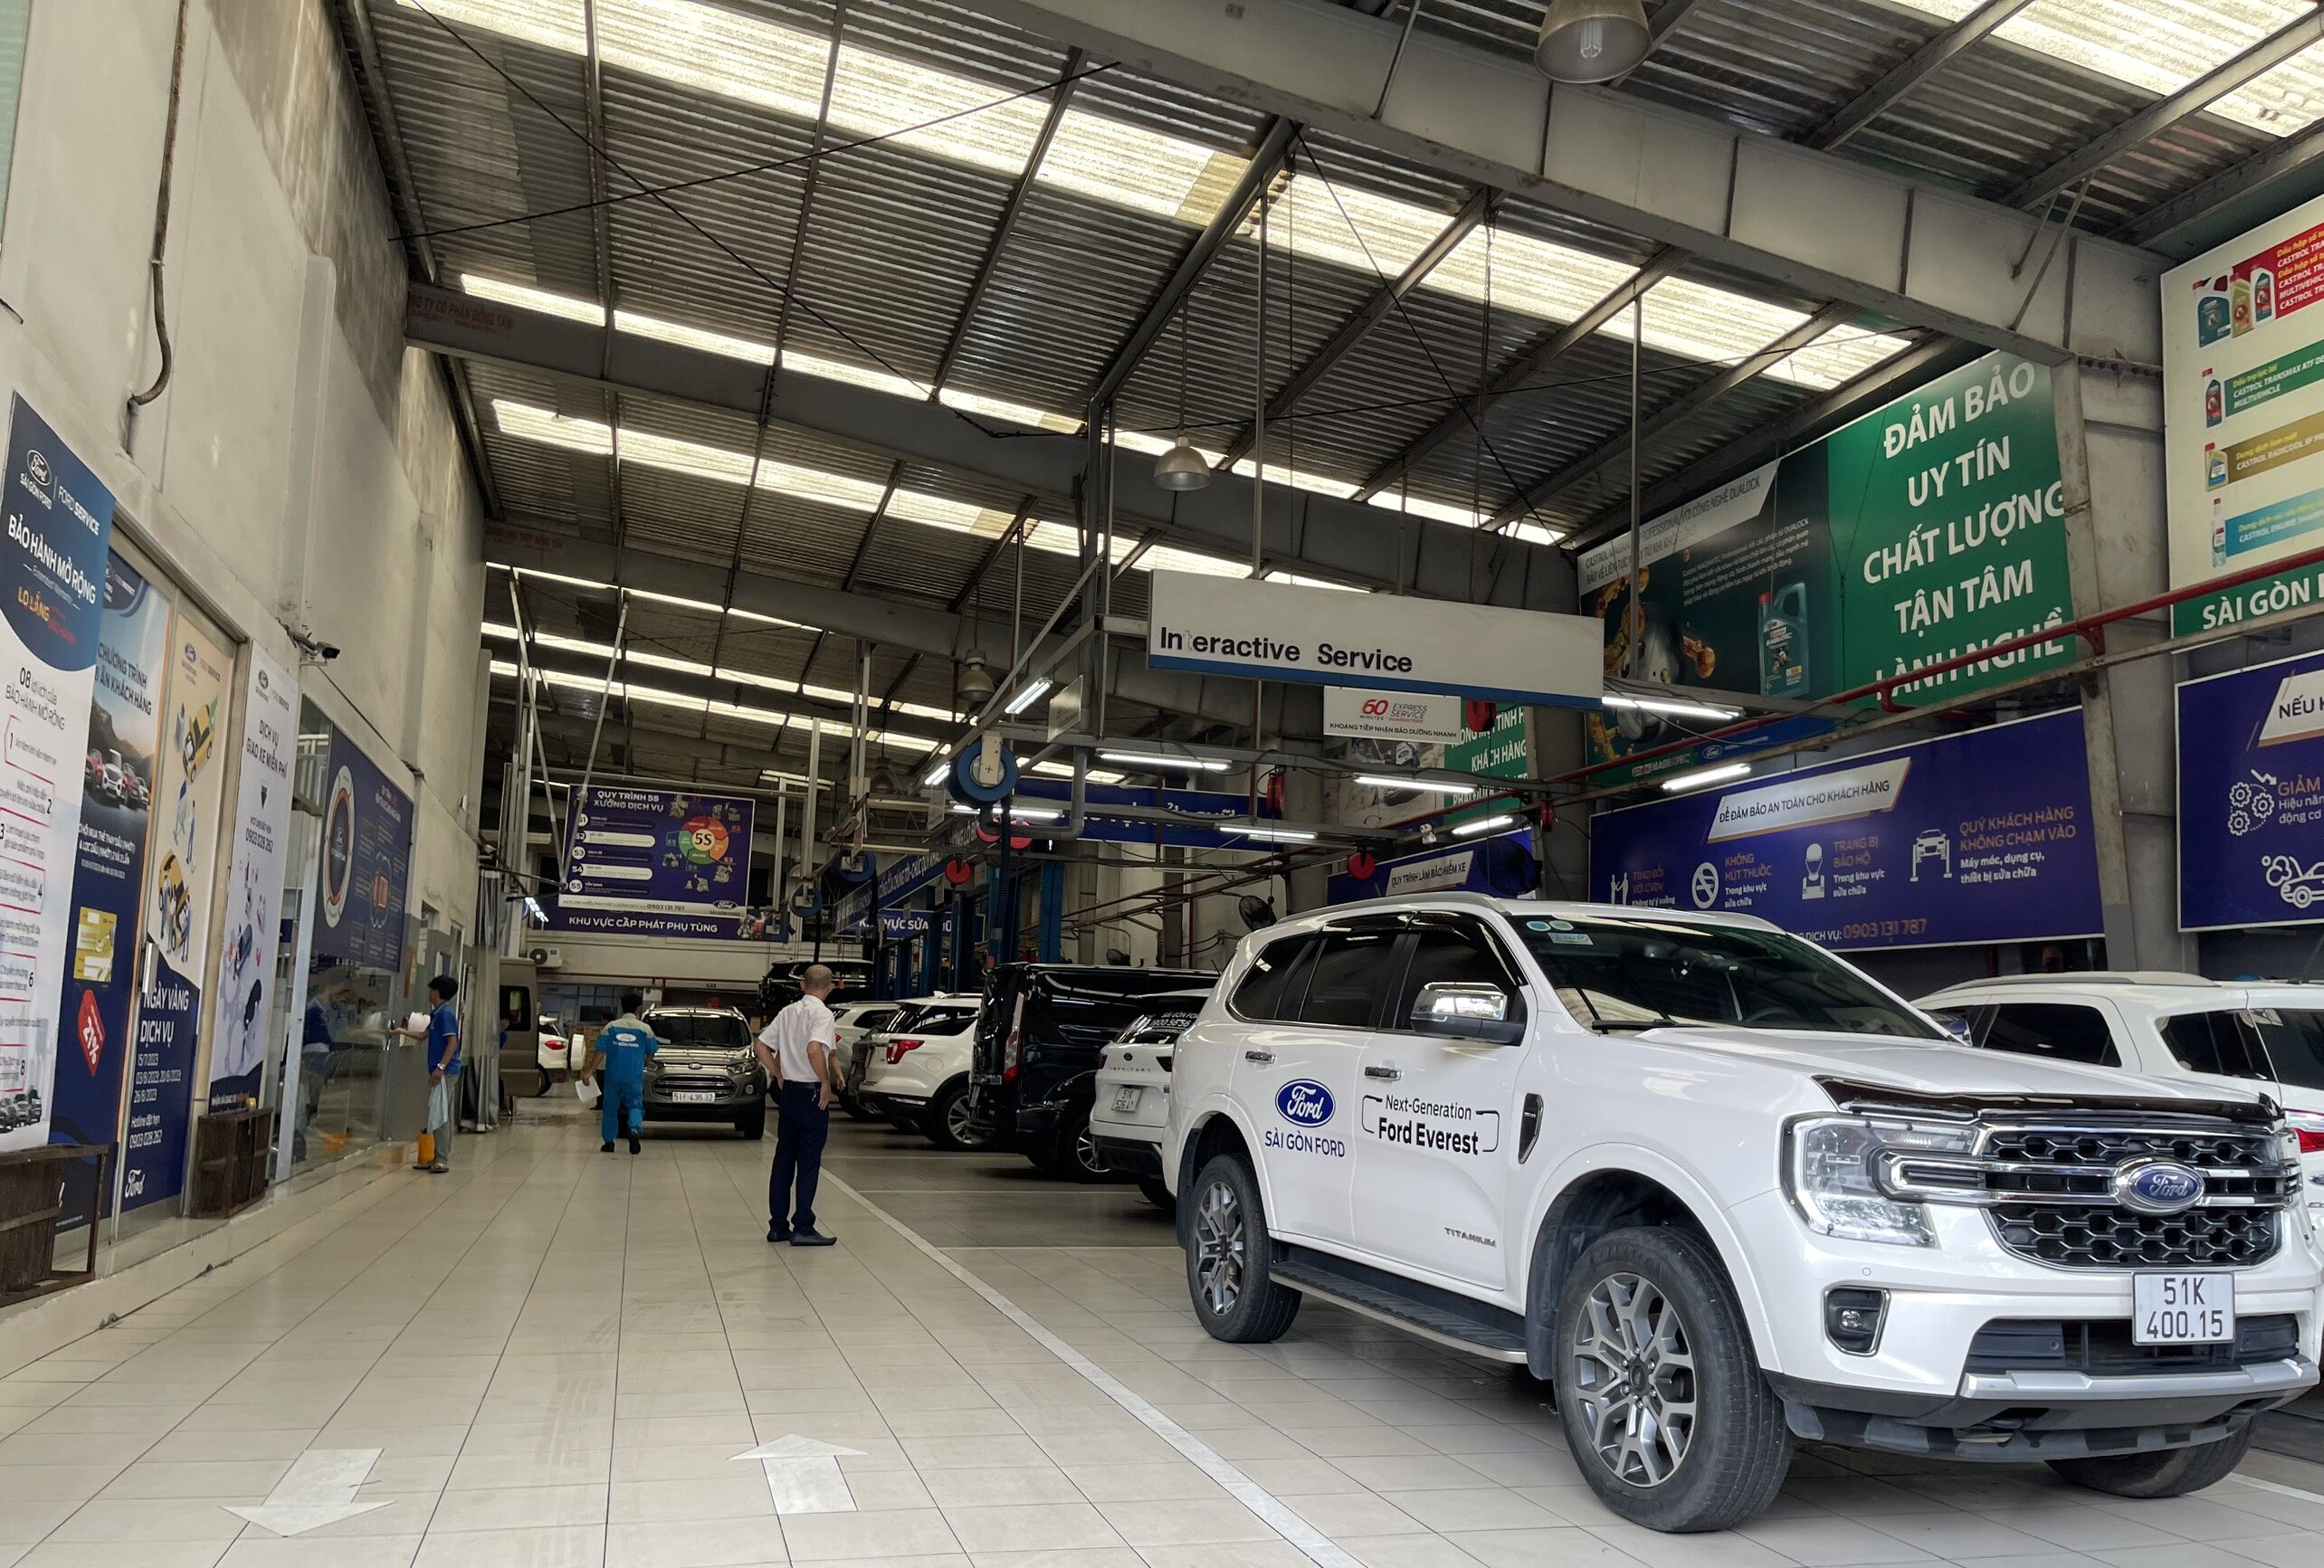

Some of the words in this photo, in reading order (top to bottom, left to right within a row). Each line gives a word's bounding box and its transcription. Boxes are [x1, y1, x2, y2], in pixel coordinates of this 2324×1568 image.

[2277, 247, 2310, 268] CASTROL
[2279, 268, 2312, 289] CASTROL
[2280, 290, 2313, 310] CASTROL
[2234, 381, 2263, 399] CASTROL
[1883, 396, 1957, 460] ĐẢM
[1964, 361, 2035, 423] BẢO
[31, 453, 48, 483] Ford
[1908, 461, 1950, 508] UY
[1955, 435, 2011, 488] TÍN
[2236, 454, 2267, 470] CASTROL
[58, 484, 74, 512] FORD
[73, 500, 100, 537] SERVICE
[1862, 523, 1940, 585] CHẤT
[1948, 480, 2065, 556] LƯỢNG
[2239, 527, 2271, 544] CASTROL
[8, 513, 30, 550] BẢO
[30, 533, 58, 574] HÀNH
[56, 556, 73, 585] MỞ
[71, 569, 97, 605] RỘNG
[17, 585, 30, 608] LO
[1893, 584, 1955, 638] TẬN
[1960, 558, 2034, 613] TÂM
[2203, 595, 2243, 631] SÀI
[2249, 577, 2310, 616] GÒN
[97, 641, 128, 677] CHƯƠNG
[128, 662, 148, 690] TRÌNH
[1317, 641, 1414, 673] Service
[19, 666, 32, 689] 08
[100, 665, 110, 689] ÂN
[110, 675, 134, 707] KHÁCH
[133, 689, 152, 717] HÀNG
[1361, 698, 1390, 716] 60
[1390, 709, 1425, 719] SERVICE
[1392, 702, 1428, 712] EXPRESS
[2279, 695, 2315, 719] NẾU
[259, 718, 272, 740] DỊCH
[271, 726, 281, 751] VỤ
[1329, 722, 1358, 731] KHOANG
[1359, 720, 1374, 731] TIẾP
[1394, 724, 1409, 735] BẢO
[1433, 730, 1458, 738] NHANH
[246, 736, 259, 761] GIAO
[258, 746, 267, 765] XE
[277, 761, 290, 779] PHÍ
[1472, 747, 1500, 773] KHÁCH
[1501, 739, 1527, 764] HÀNG
[2277, 774, 2321, 796] GIẢM
[46, 798, 52, 814] 2
[597, 791, 617, 799] QUY
[618, 792, 647, 802] TRÌNH
[647, 794, 660, 803] 5S
[627, 802, 650, 812] DỊCH
[651, 804, 664, 813] VỤ
[1719, 806, 1730, 823] ĐỂ
[1730, 806, 1748, 822] ĐẢM
[1750, 802, 1767, 817] BẢO
[1767, 801, 1780, 813] AN
[1781, 796, 1805, 811] TOÀN
[1806, 794, 1826, 807] CHO
[1827, 786, 1860, 803] KHÁCH
[1862, 780, 1891, 796] HÀNG
[2279, 798, 2303, 811] Hiệu
[1959, 816, 1986, 837] QUÝ
[1988, 811, 2033, 831] KHÁCH
[2034, 805, 2075, 824] HÀNG
[2279, 812, 2307, 826] động
[2308, 808, 2322, 820] cơ
[694, 832, 712, 846] 5S
[1833, 837, 1867, 852] TRANG
[1960, 833, 2005, 852] KHÔNG
[2006, 829, 2045, 847] CHẠM
[2047, 822, 2076, 841] VÀO
[571, 865, 584, 873] S4
[1724, 852, 1755, 867] KHÔNG
[1833, 852, 1853, 869] BẢO
[1854, 851, 1872, 867] HỘ
[1960, 857, 1980, 870] Máy
[1980, 854, 2003, 866] móc,
[2004, 851, 2028, 865] dụng
[2030, 851, 2045, 863] cụ,
[1391, 874, 1403, 888] QUY
[1458, 862, 1466, 874] XE
[1743, 864, 1773, 879] THUỐC
[1833, 873, 1855, 884] Trong
[1855, 870, 1870, 880] khu
[1870, 868, 1885, 880] vực
[1960, 870, 1982, 884] thiết
[1983, 870, 1993, 884] bị
[1993, 868, 2011, 880] sửa
[2012, 866, 2037, 879] chữa
[570, 881, 582, 889] S5
[1724, 885, 1742, 896] Trong
[1742, 883, 1756, 894] khu
[1755, 881, 1767, 894] vực
[1833, 886, 1847, 898] sửa
[1847, 885, 1867, 896] chữa
[1737, 898, 1752, 908] chữa
[568, 917, 592, 927] KHU
[593, 917, 615, 928] VỰC
[638, 918, 665, 930] PHÁT
[666, 922, 688, 933] PHỤ
[690, 921, 719, 933] TÙNG
[908, 917, 929, 931] SỬA
[1827, 929, 1843, 943] VỤ:
[1843, 922, 1879, 939] 0903
[1881, 920, 1900, 936] 131
[1901, 917, 1928, 936] 787
[28, 971, 34, 988] 6
[143, 980, 168, 1011] NGÀY
[167, 983, 190, 1012] VÀNG
[139, 1019, 162, 1049] DỊCH
[162, 1021, 175, 1049] VỤ
[20, 1060, 25, 1076] 8
[1287, 1086, 1325, 1120] Ford
[1386, 1094, 1472, 1121] Next-Generation
[1264, 1126, 1284, 1149] SÀI
[1286, 1129, 1313, 1153] GÒN
[1315, 1136, 1346, 1158] FORD
[1378, 1117, 1413, 1145] Ford
[1415, 1123, 1479, 1155] Everest
[125, 1168, 146, 1199] Ford
[2148, 1174, 2188, 1198] Ford
[1443, 1226, 1497, 1248] TITANIUM
[2164, 1277, 2205, 1306] 51K
[2146, 1310, 2224, 1340] 400.15
